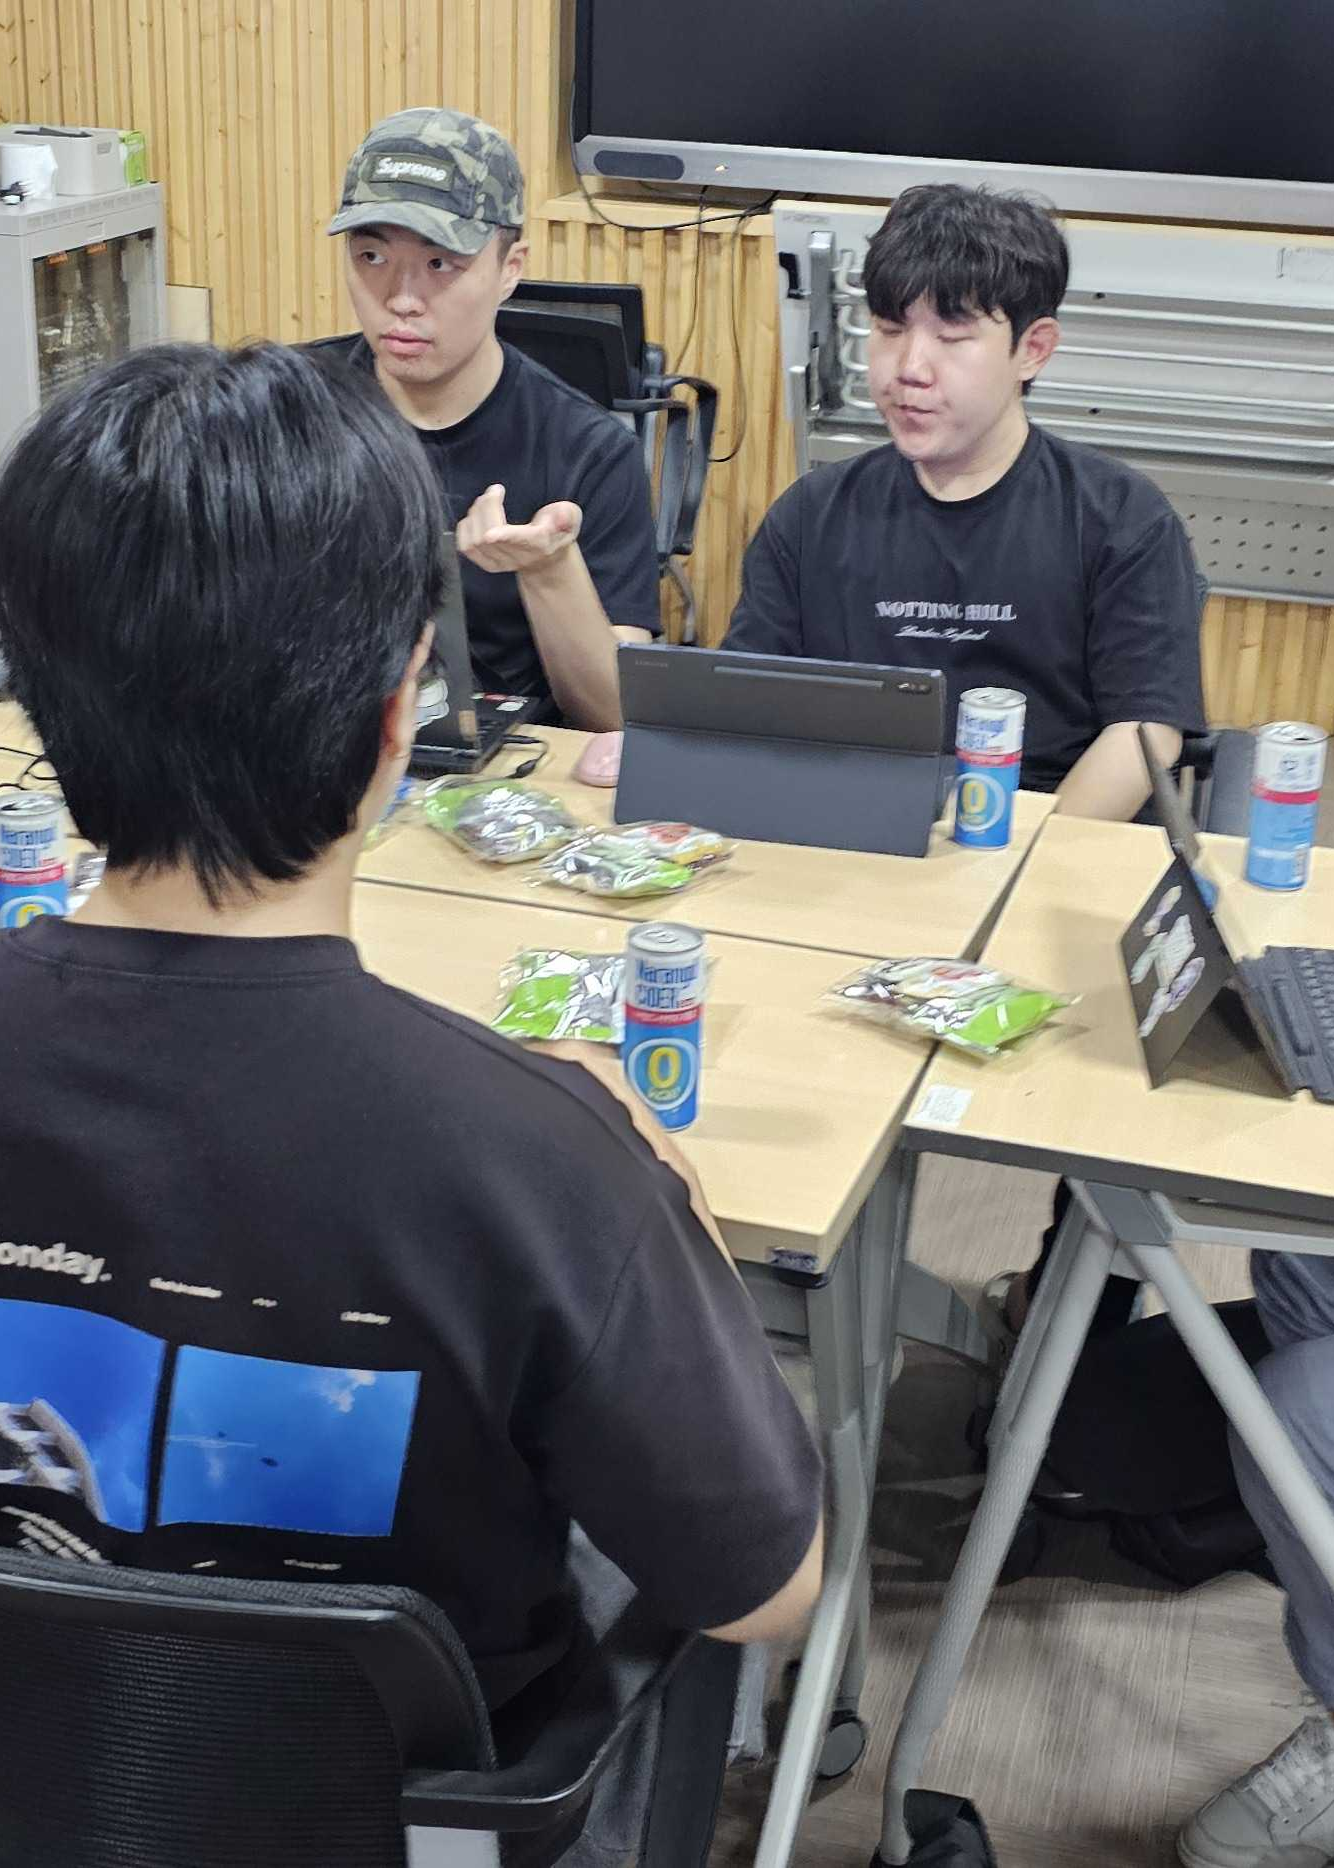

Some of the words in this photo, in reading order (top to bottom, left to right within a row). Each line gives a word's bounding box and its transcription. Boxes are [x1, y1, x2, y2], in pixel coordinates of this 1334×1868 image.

[376, 157, 447, 181] Supreme
[875, 601, 964, 619] NOTTING
[964, 604, 1017, 621] HILL
[648, 1046, 681, 1089] 0
